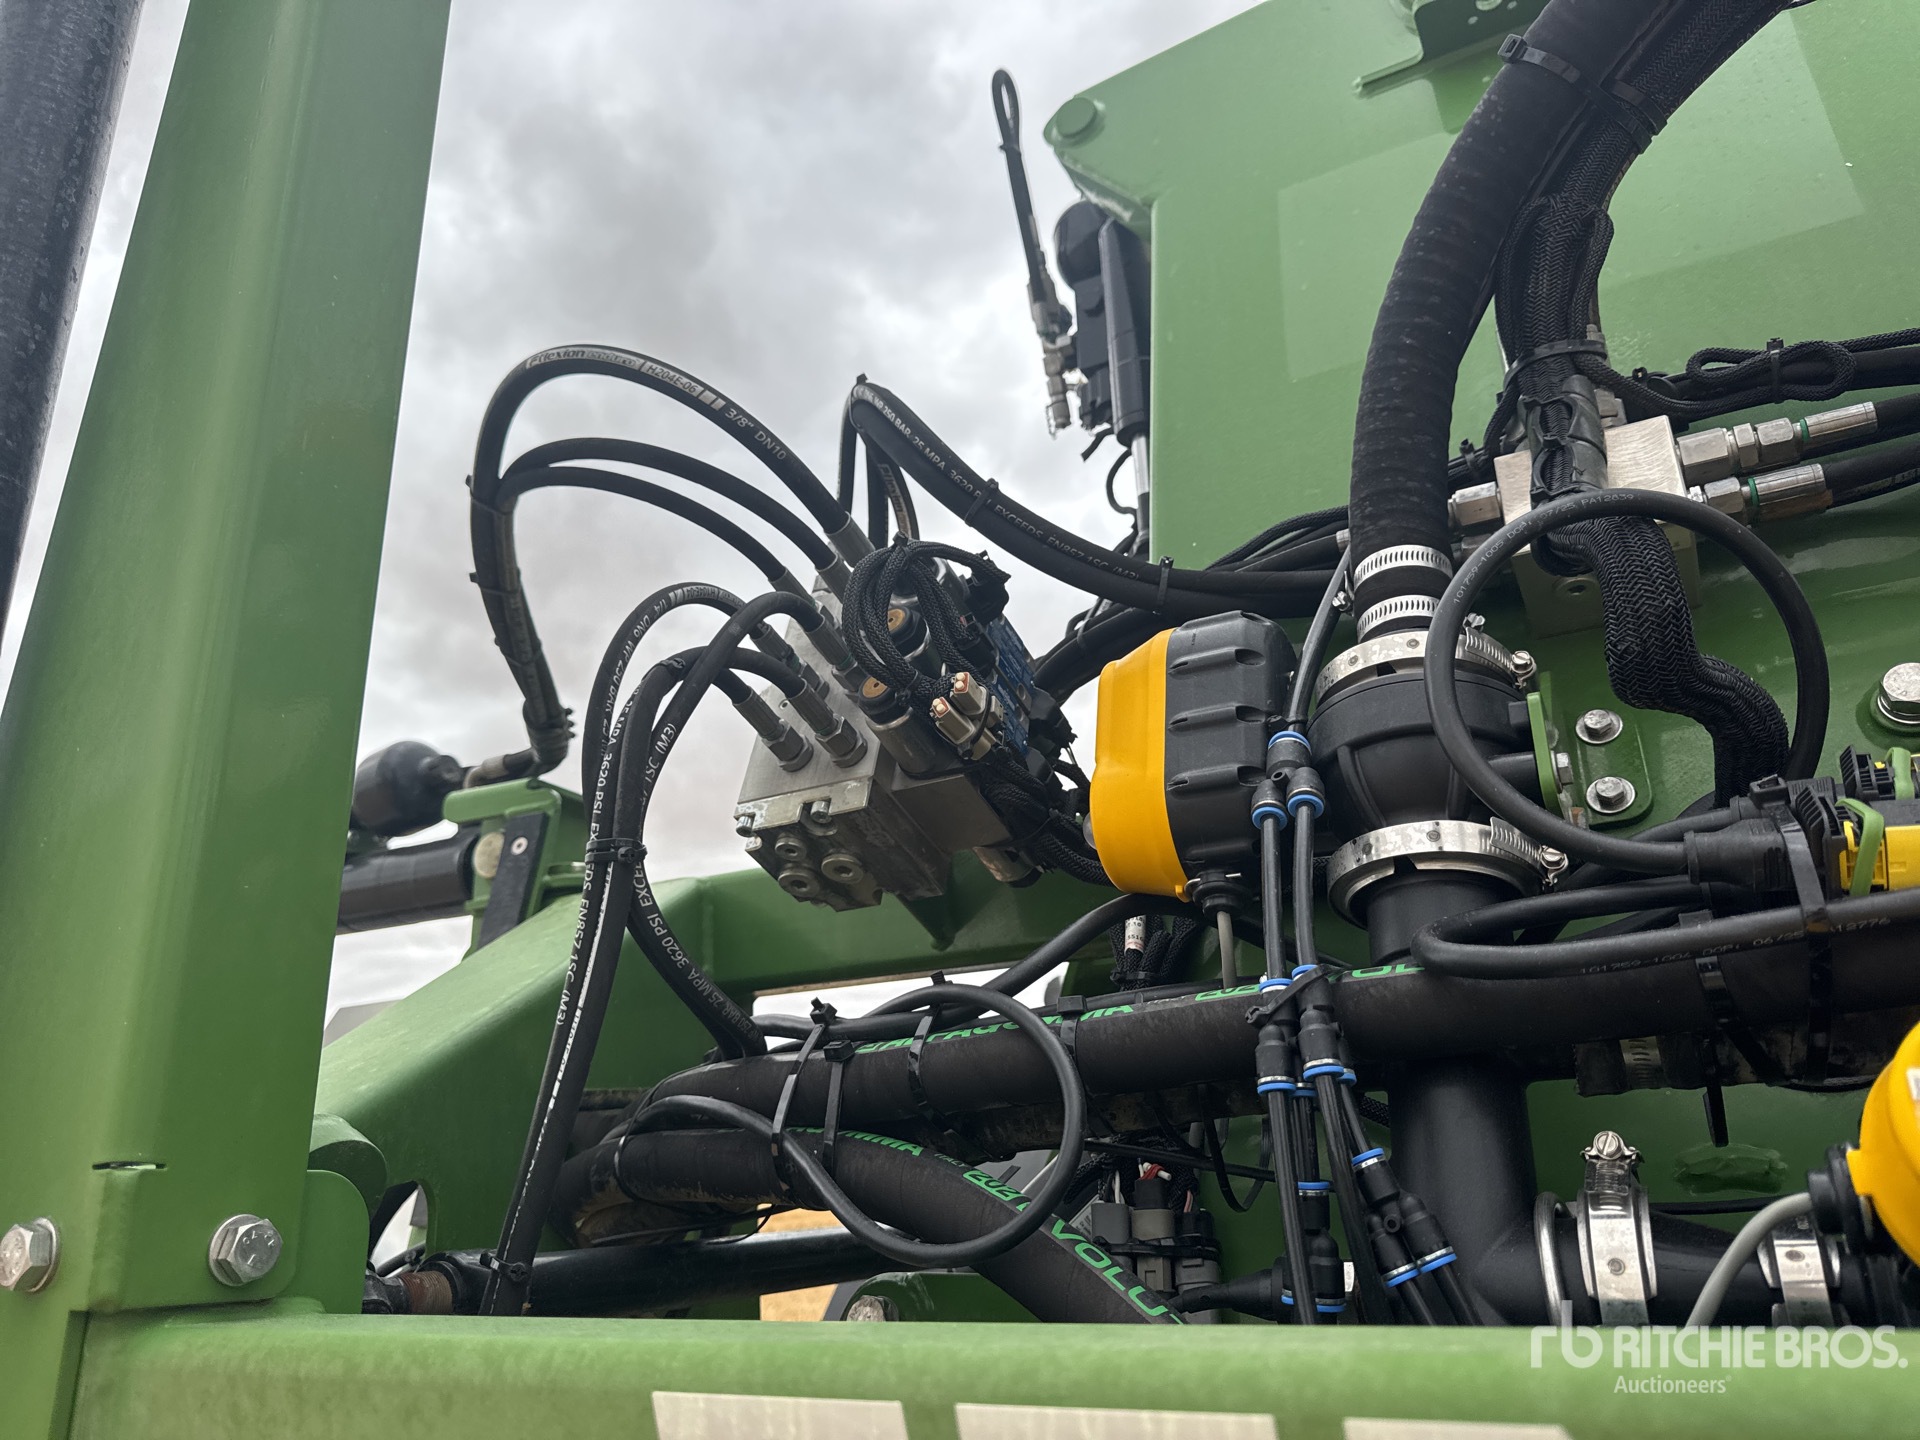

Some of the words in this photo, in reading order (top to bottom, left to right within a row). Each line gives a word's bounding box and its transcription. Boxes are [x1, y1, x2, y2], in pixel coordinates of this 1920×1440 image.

[646, 364, 698, 394] H204E-06
[754, 430, 787, 461] DN10
[883, 406, 896, 422] 250
[895, 417, 911, 438] BAR
[913, 436, 925, 451] 25
[924, 447, 946, 470] MPA
[949, 469, 974, 494] 3620
[994, 504, 1044, 539] EXCEEDS
[1453, 540, 1504, 604] 101759-1005
[655, 723, 677, 754] (M3)
[597, 753, 612, 787] 3620
[593, 791, 605, 815] PSI
[573, 898, 590, 950] EN857
[647, 912, 669, 937] PSI
[566, 953, 580, 983] 1SC
[661, 935, 689, 969] 3620
[687, 967, 713, 996] MPA
[556, 989, 571, 1026] (M3)
[709, 991, 724, 1008] 25
